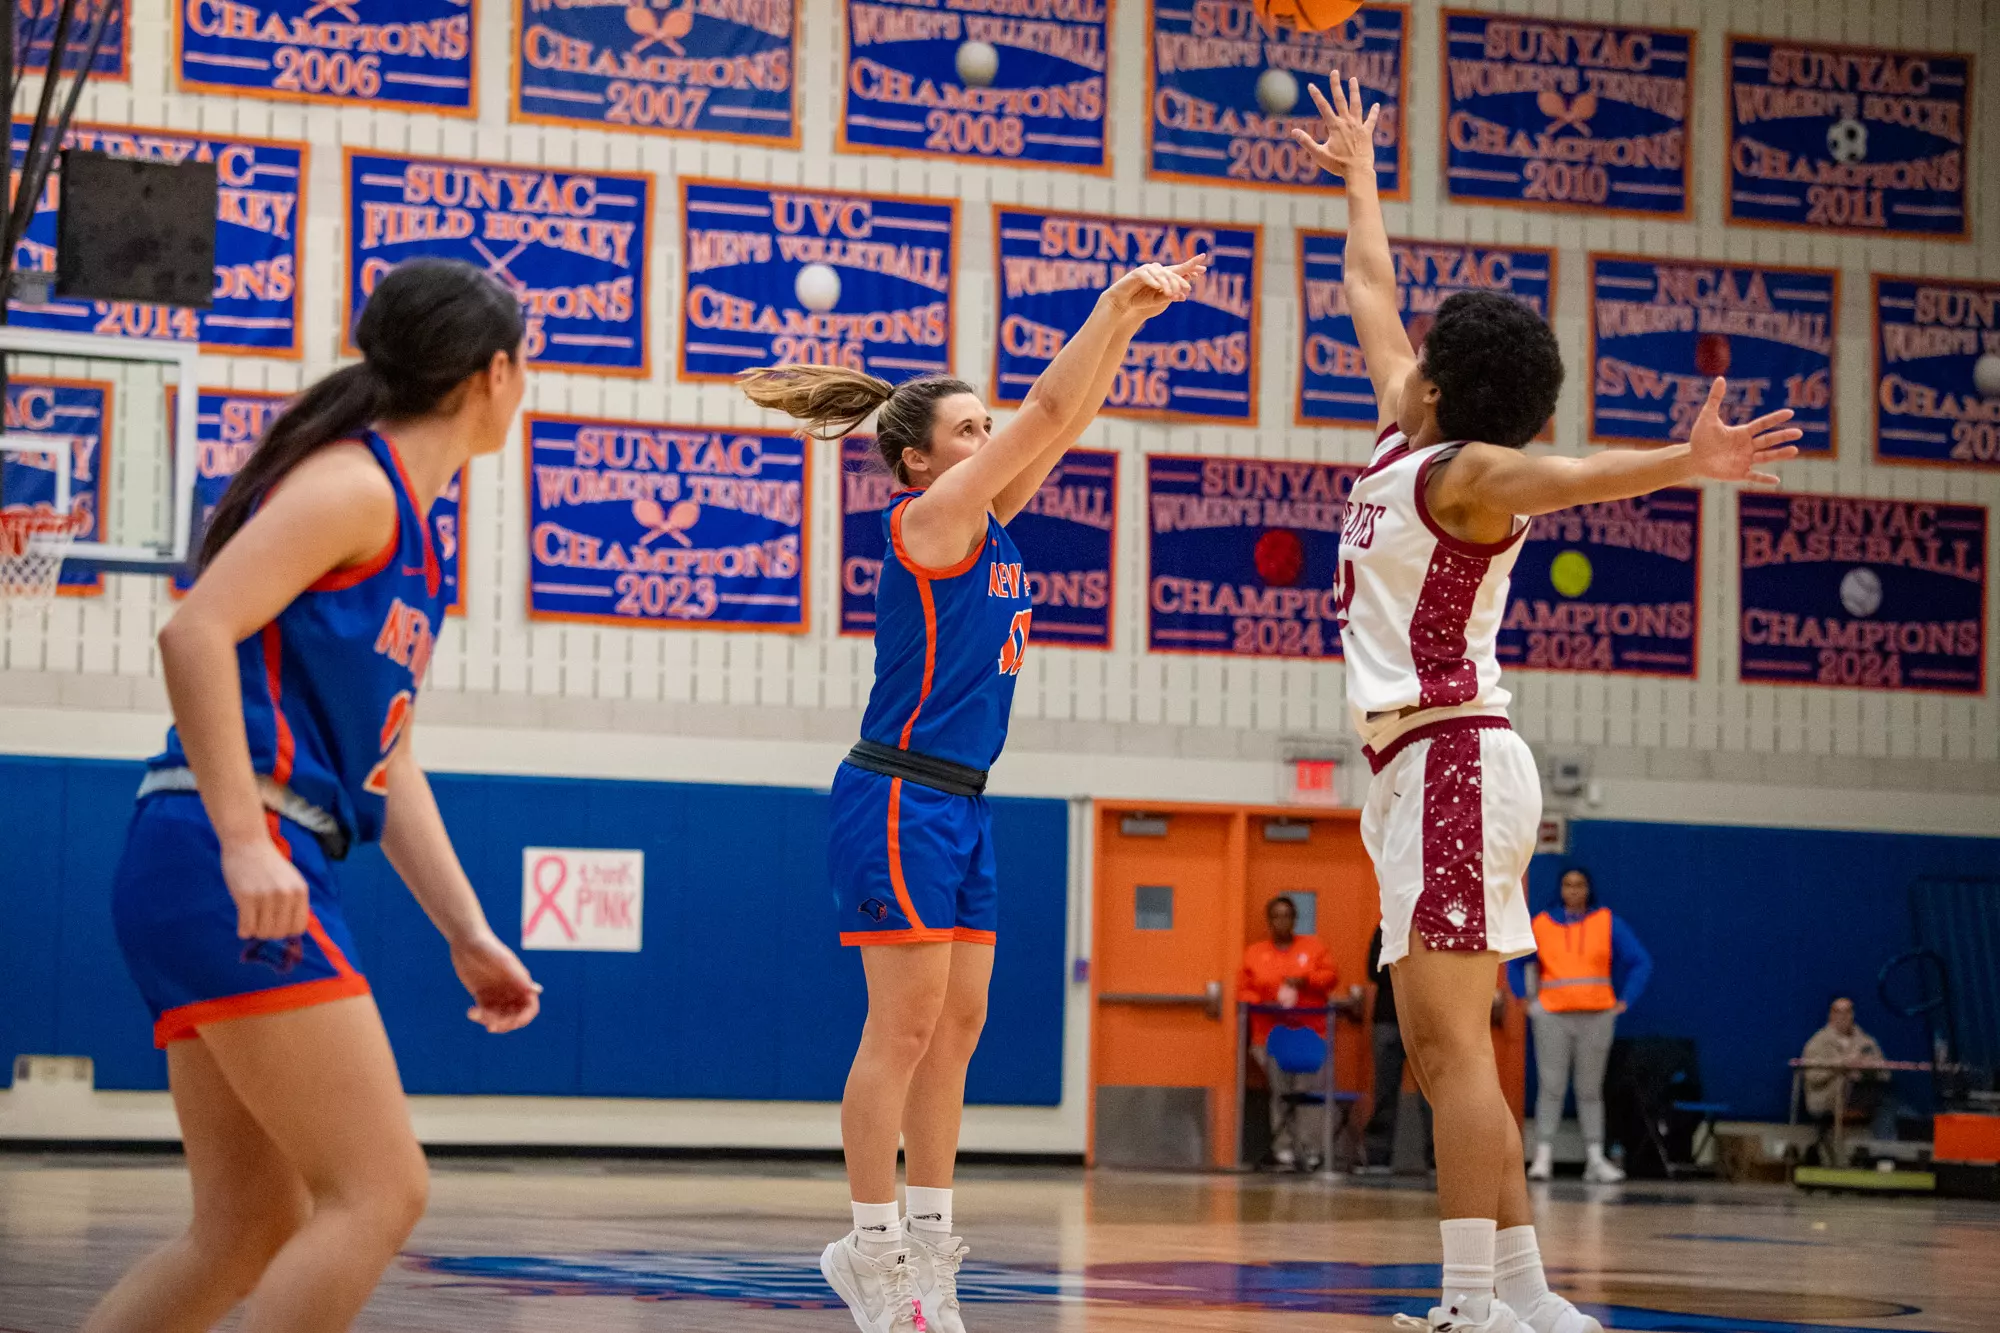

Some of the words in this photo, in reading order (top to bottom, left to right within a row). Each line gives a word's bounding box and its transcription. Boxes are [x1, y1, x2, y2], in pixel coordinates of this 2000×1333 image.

[187, 1, 469, 60] CHAMPIONS
[851, 4, 961, 46] WOMEN'S
[965, 14, 1105, 72] VOLLEYBALL
[1485, 21, 1652, 70] SUNYAC
[272, 49, 381, 98] 2006
[523, 25, 790, 93] CHAMPIONS
[1156, 32, 1262, 74] WOMEN'S
[1264, 43, 1398, 98] VOLLEYBALL
[1769, 47, 1930, 95] SUNYAC
[604, 81, 710, 129] 2007
[850, 57, 1104, 120] CHAMPIONS
[1450, 58, 1579, 100] WOMEN'S
[1585, 69, 1686, 121] TENNIS
[1734, 83, 1858, 124] WOMEN'S
[925, 109, 1024, 157] 2008
[1449, 110, 1682, 169] CHAMPIONS
[1227, 138, 1322, 184] 2009
[1523, 161, 1608, 201] 2010
[1732, 139, 1960, 191] CHAMPIONS
[403, 164, 597, 217] SUNYAC
[1806, 185, 1886, 227] 2011
[361, 202, 475, 250] FIELD
[485, 212, 635, 268] HOCKEY
[770, 194, 872, 239] UVC
[688, 229, 772, 274] MEN'S
[776, 235, 948, 294] VOLLEYBALL
[1003, 257, 1107, 298] WOMEN'S
[1388, 247, 1512, 290] NYAC
[1654, 267, 1772, 313] NCAA
[93, 302, 200, 339] 2014
[687, 284, 948, 347] CHAMPIONS
[1597, 301, 1694, 340] WOMEN'S
[1699, 307, 1831, 357] BASKETBALL
[1105, 367, 1170, 408] 016
[1784, 369, 1830, 409] 16
[575, 427, 763, 476] SUNYAC
[535, 466, 681, 510] WOMEN'S
[686, 477, 801, 527] TENNIS
[1153, 493, 1259, 533] WOMEN'S
[1789, 498, 1937, 540] SUNYAC
[533, 522, 799, 580] CHAMPIONS
[1585, 521, 1692, 562] TENNIS
[1743, 528, 1980, 582] BASEBALL
[614, 573, 719, 619] 2023
[988, 562, 1022, 598] NEW
[1232, 618, 1323, 656] 2024
[1502, 598, 1693, 639] AMPIONS
[1742, 608, 1979, 656] CHAMPIONS
[1525, 632, 1614, 669] 2024
[1817, 650, 1902, 687] 2024
